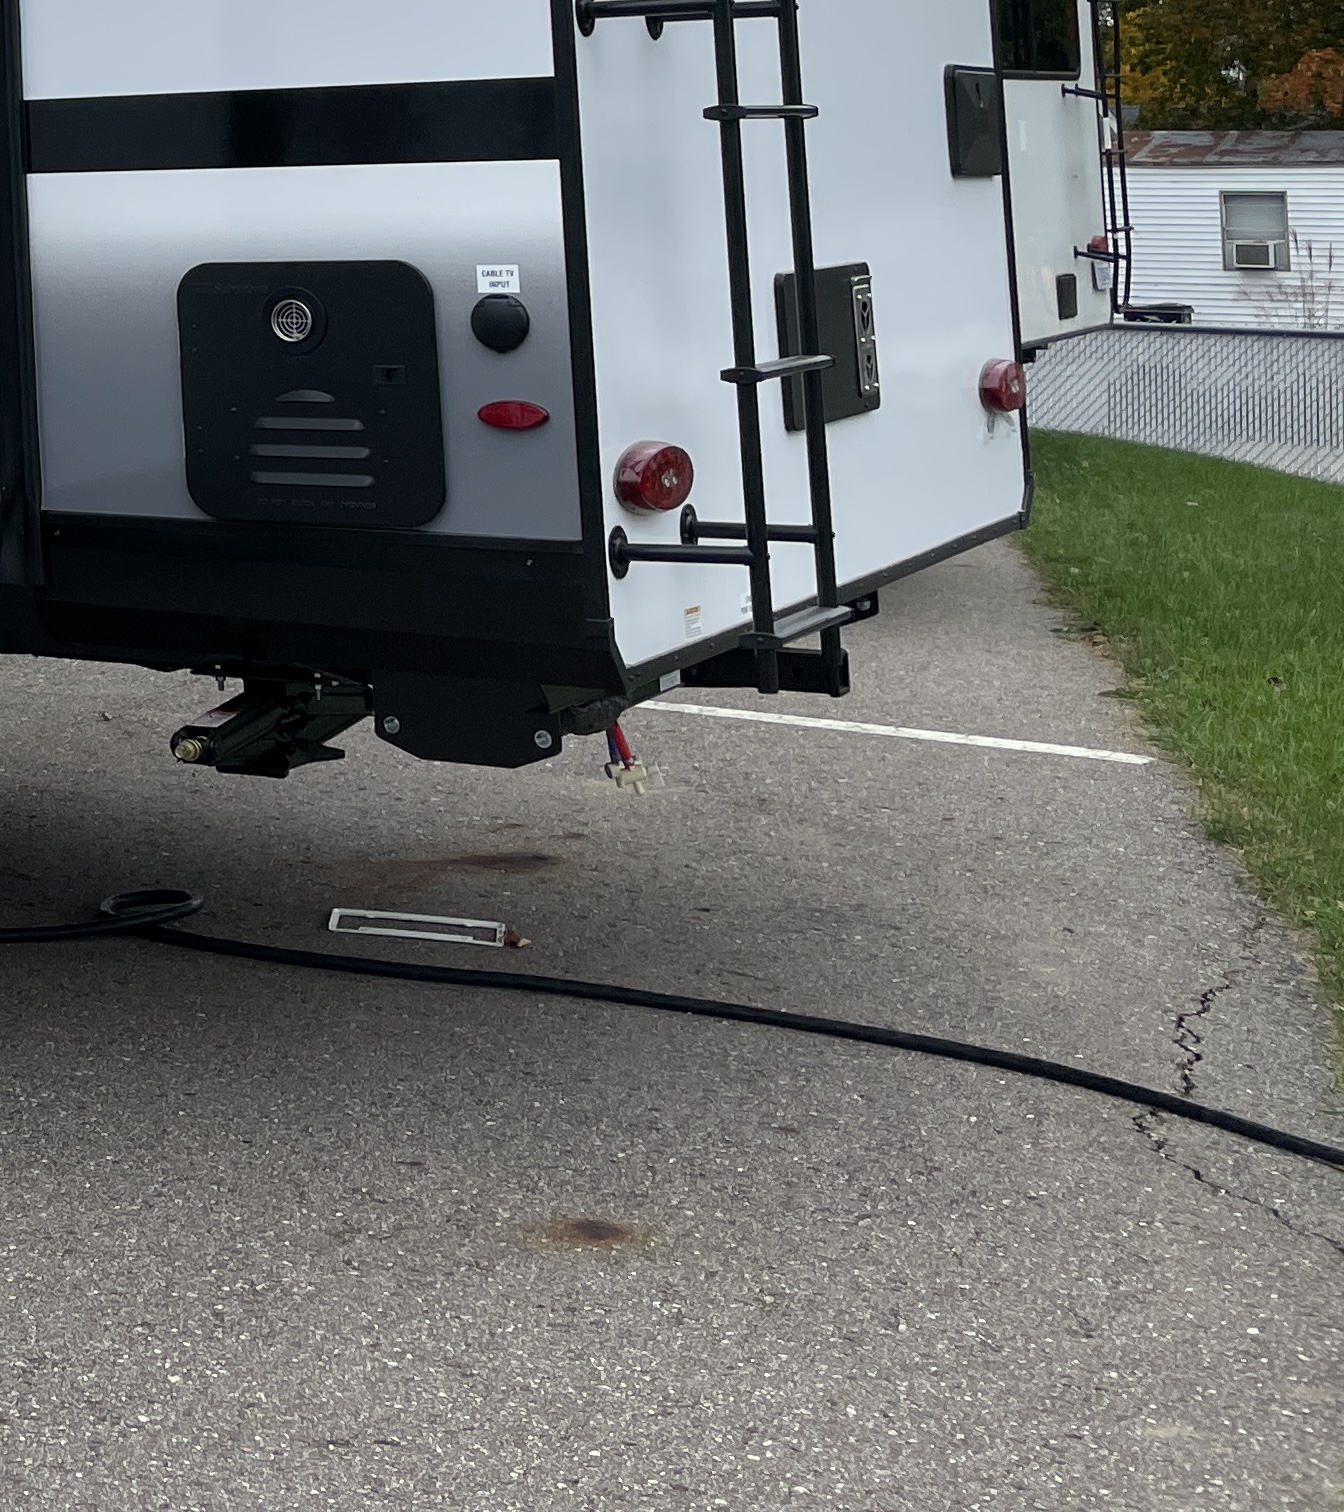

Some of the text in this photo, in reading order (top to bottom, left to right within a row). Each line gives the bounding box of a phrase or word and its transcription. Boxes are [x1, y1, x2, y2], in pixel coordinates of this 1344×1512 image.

[481, 269, 514, 277] CABLE TV
[488, 280, 510, 288] INPUT
